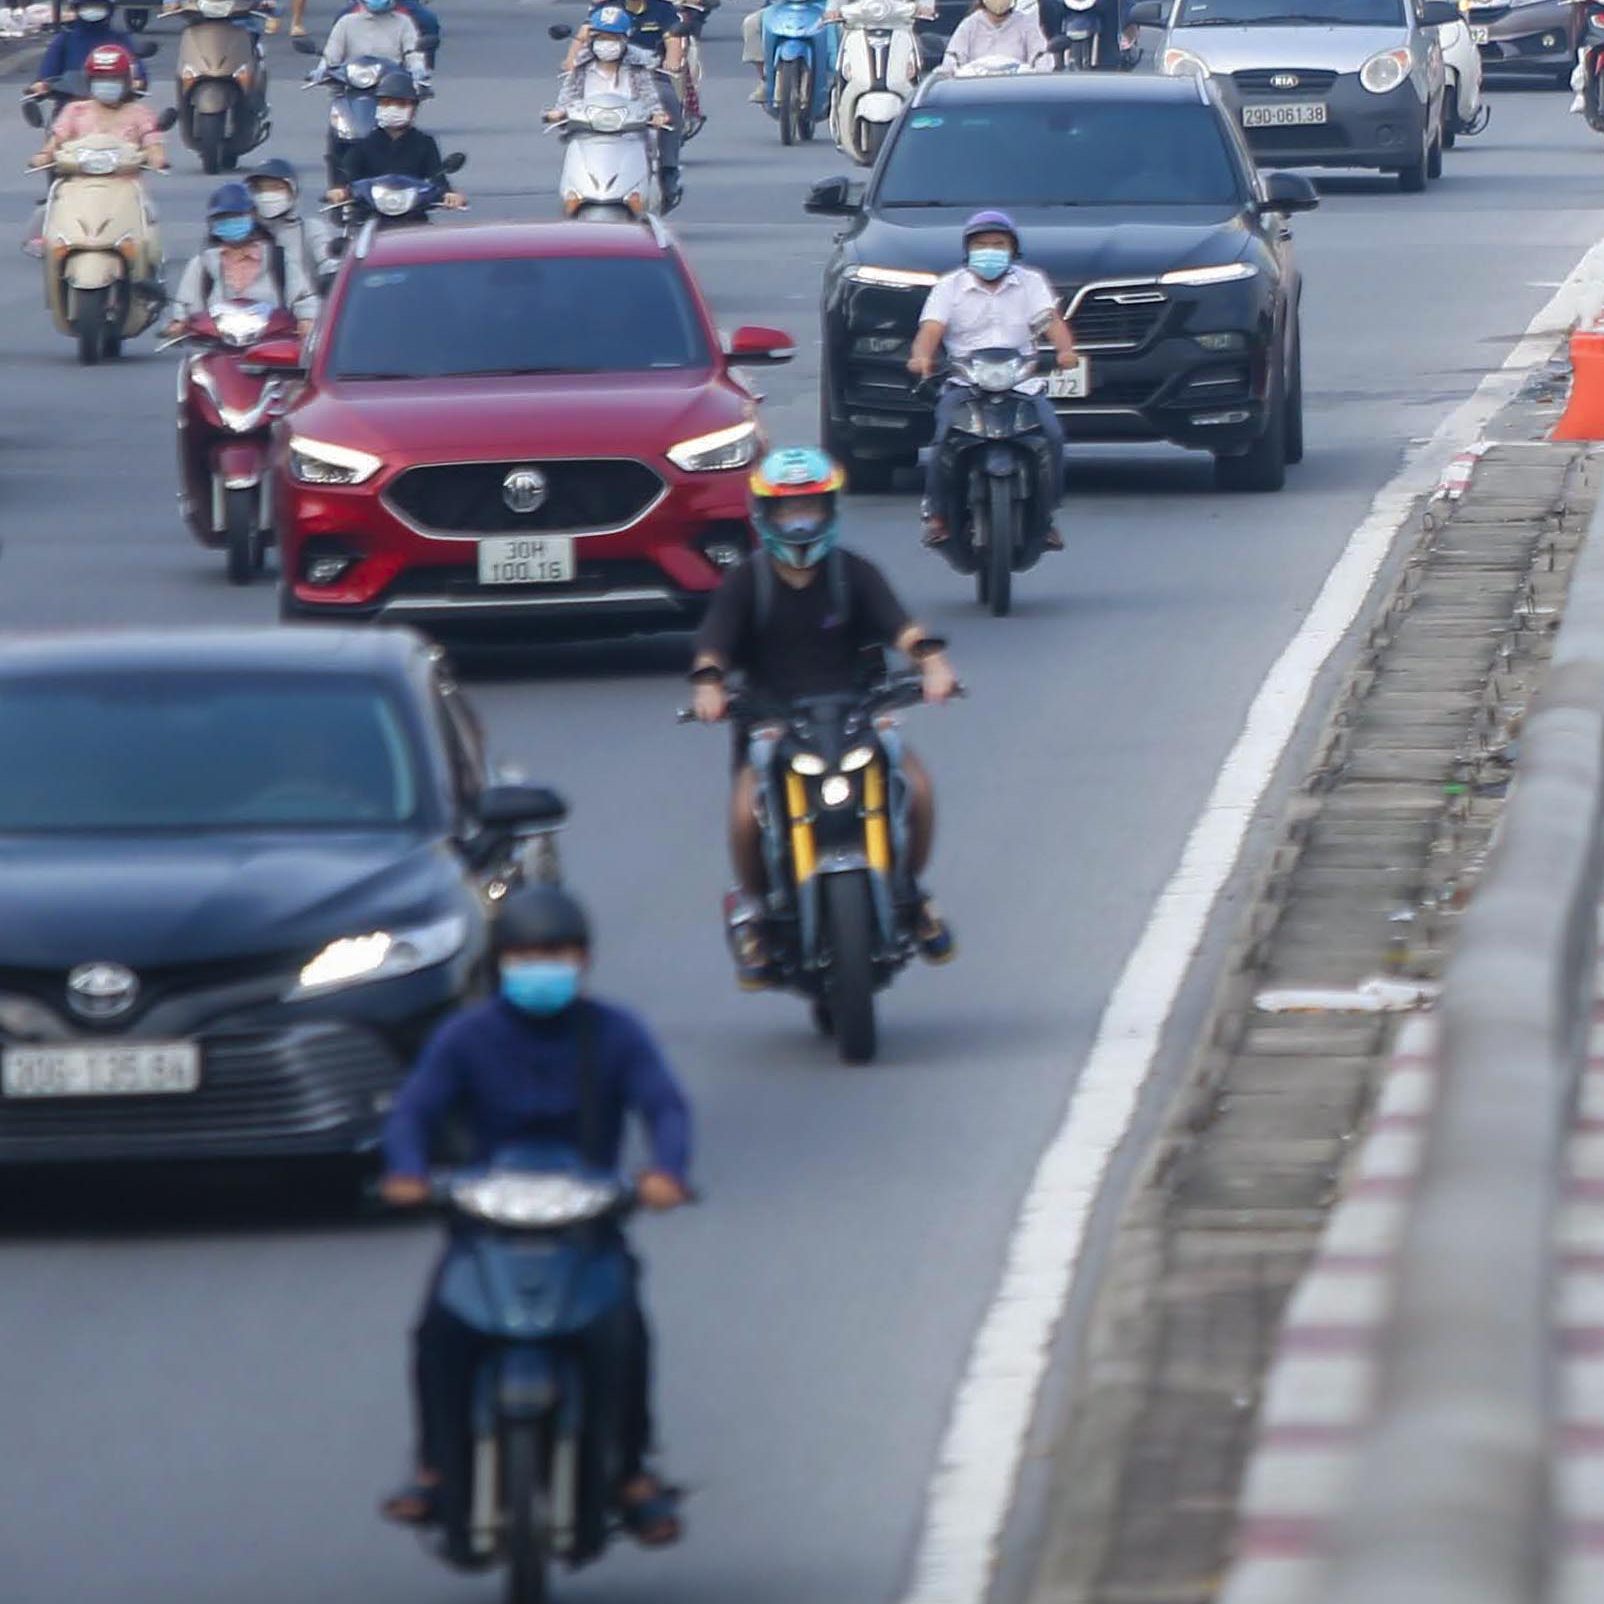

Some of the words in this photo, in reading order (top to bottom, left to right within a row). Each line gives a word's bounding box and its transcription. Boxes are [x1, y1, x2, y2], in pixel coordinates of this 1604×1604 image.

[1275, 77, 1294, 86] KIA
[1245, 105, 1324, 126] 29D-061.38
[506, 541, 545, 560] 30H
[493, 561, 562, 582] 100.16
